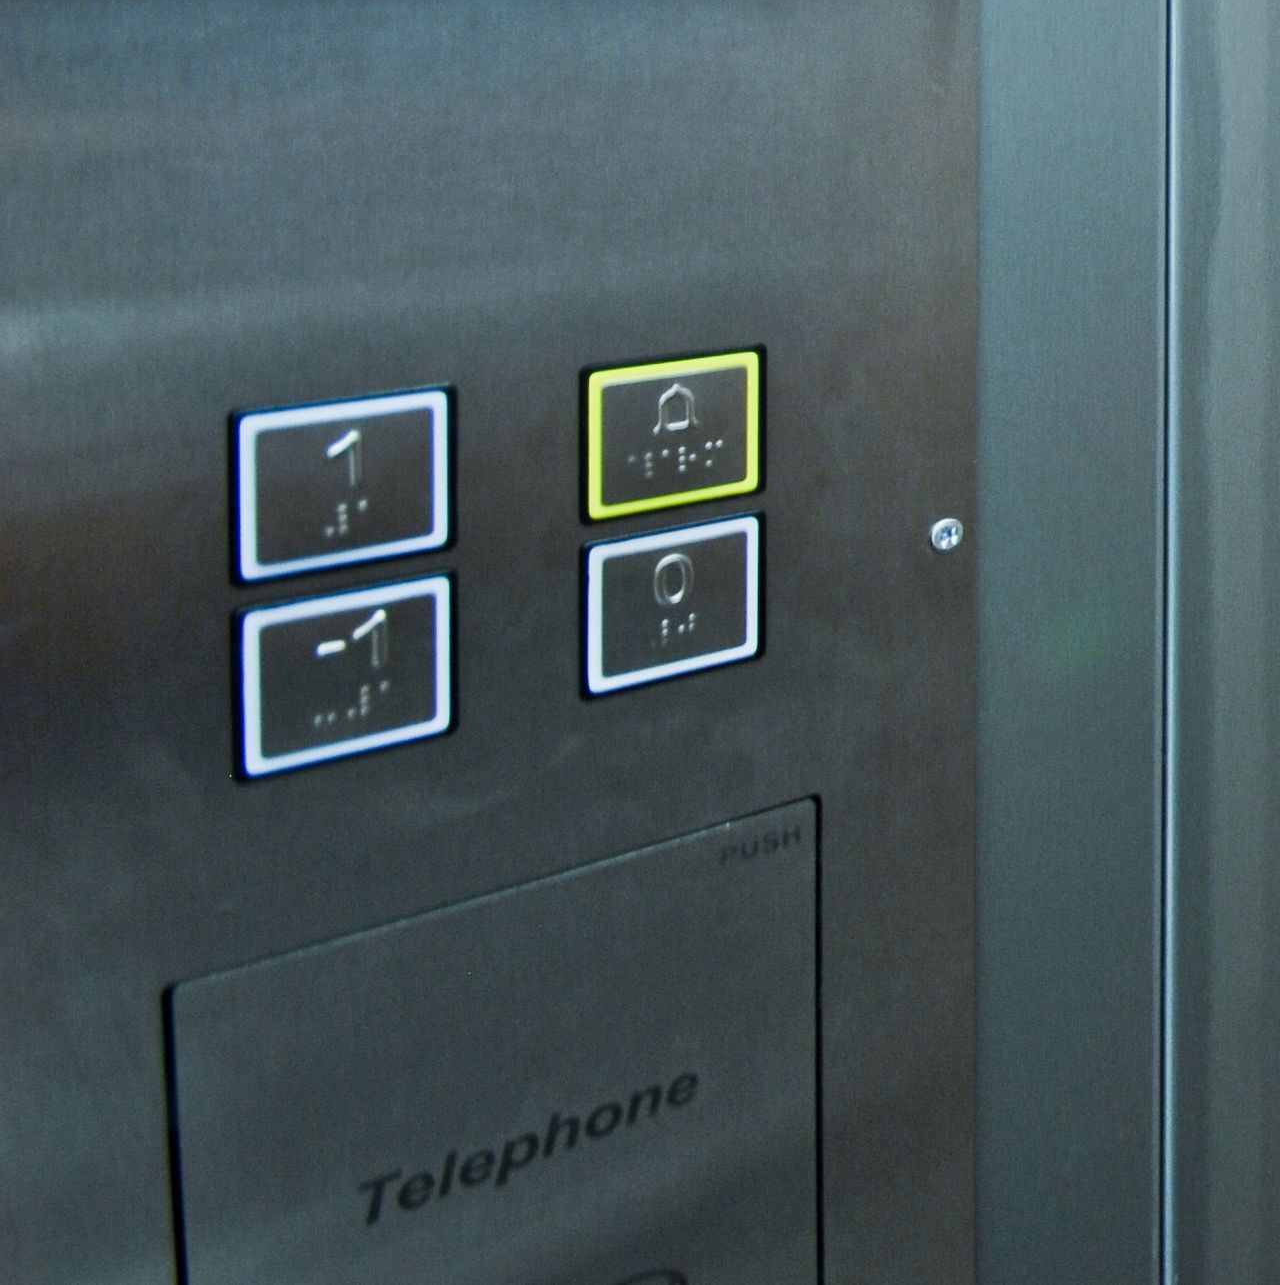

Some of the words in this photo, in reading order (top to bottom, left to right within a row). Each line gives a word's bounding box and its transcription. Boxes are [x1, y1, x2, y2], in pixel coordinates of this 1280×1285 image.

[327, 428, 362, 486] 1
[653, 552, 694, 606] 0
[316, 607, 388, 668] -1
[719, 826, 800, 867] PUSH
[357, 1071, 699, 1226] Telephone
